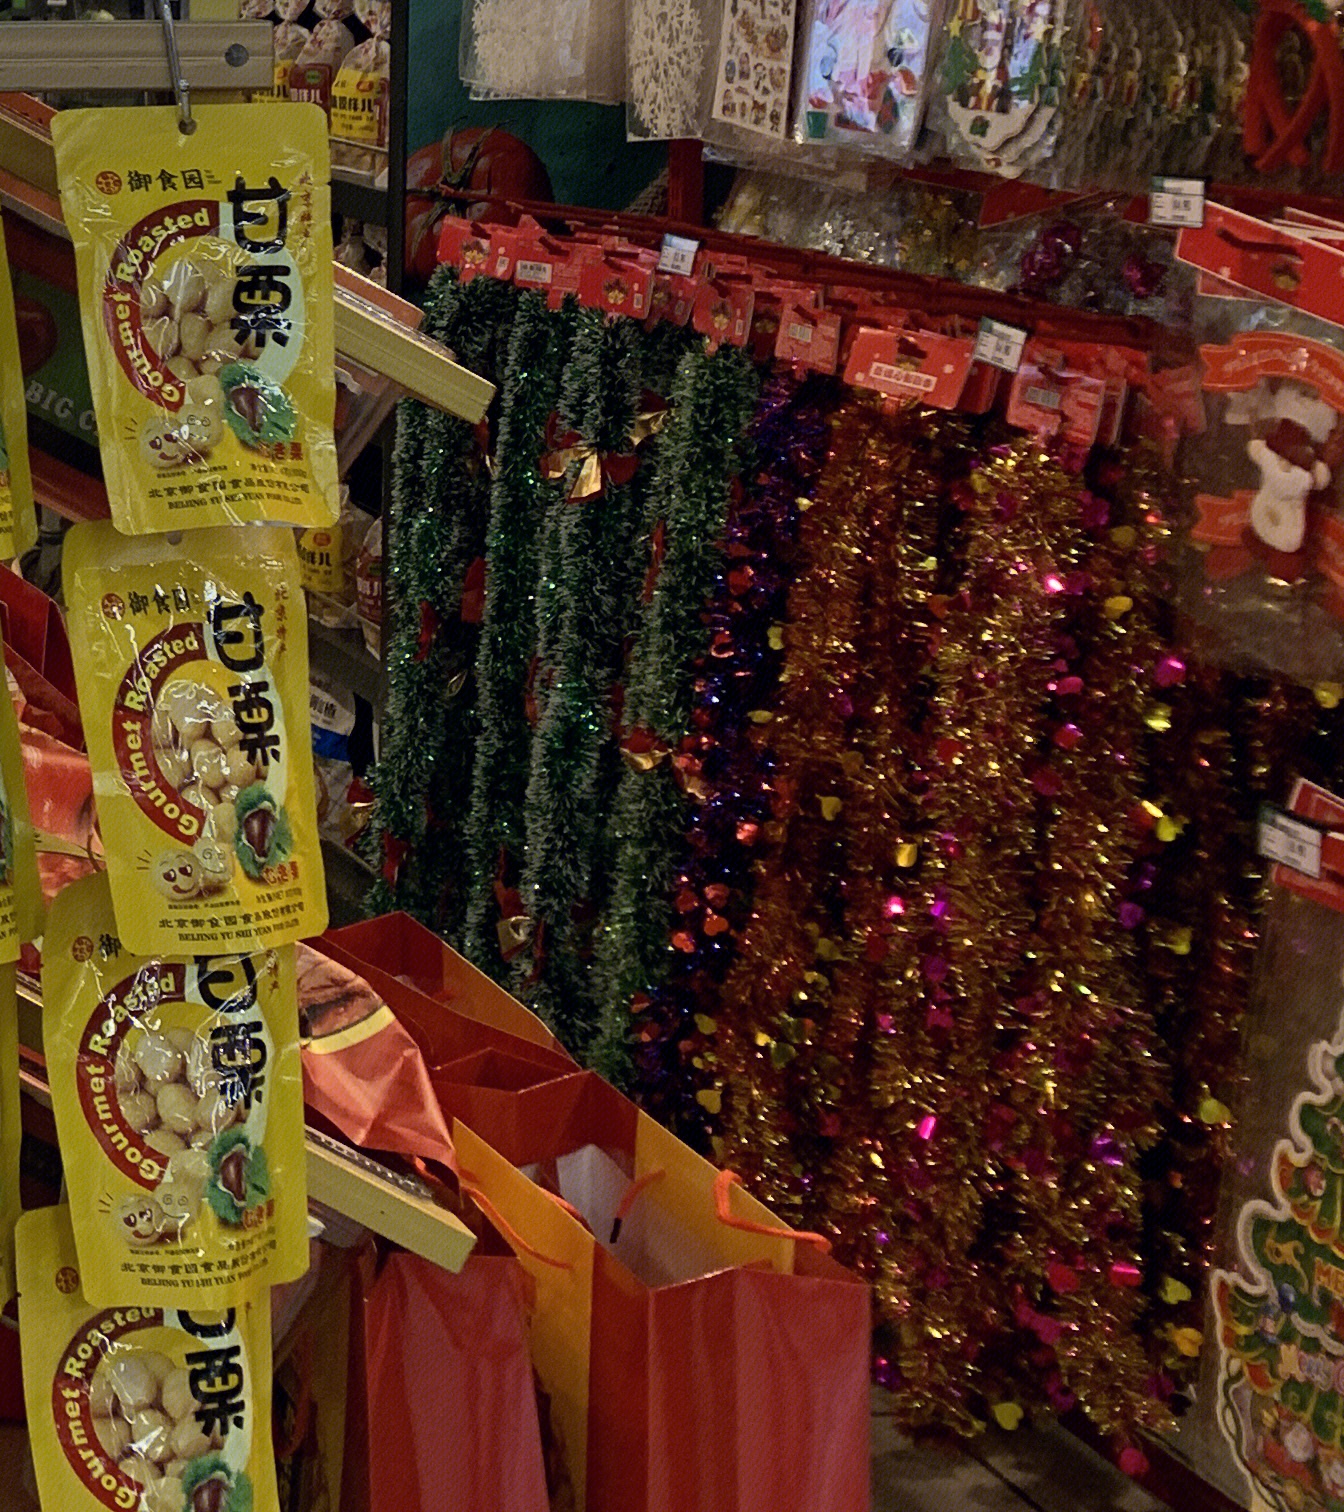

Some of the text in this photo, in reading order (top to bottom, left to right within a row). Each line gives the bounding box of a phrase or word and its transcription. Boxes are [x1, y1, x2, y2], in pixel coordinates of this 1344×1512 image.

[127, 168, 205, 193] 御食园
[113, 207, 211, 403] Gourmet Roasted
[226, 175, 292, 348] 甘栗
[25, 380, 73, 420] BIG
[122, 631, 200, 836] Gourmet Roasted
[206, 591, 280, 767] 甘栗
[85, 1062, 160, 1181] Gourmet
[61, 1387, 137, 1509] Gourmet
